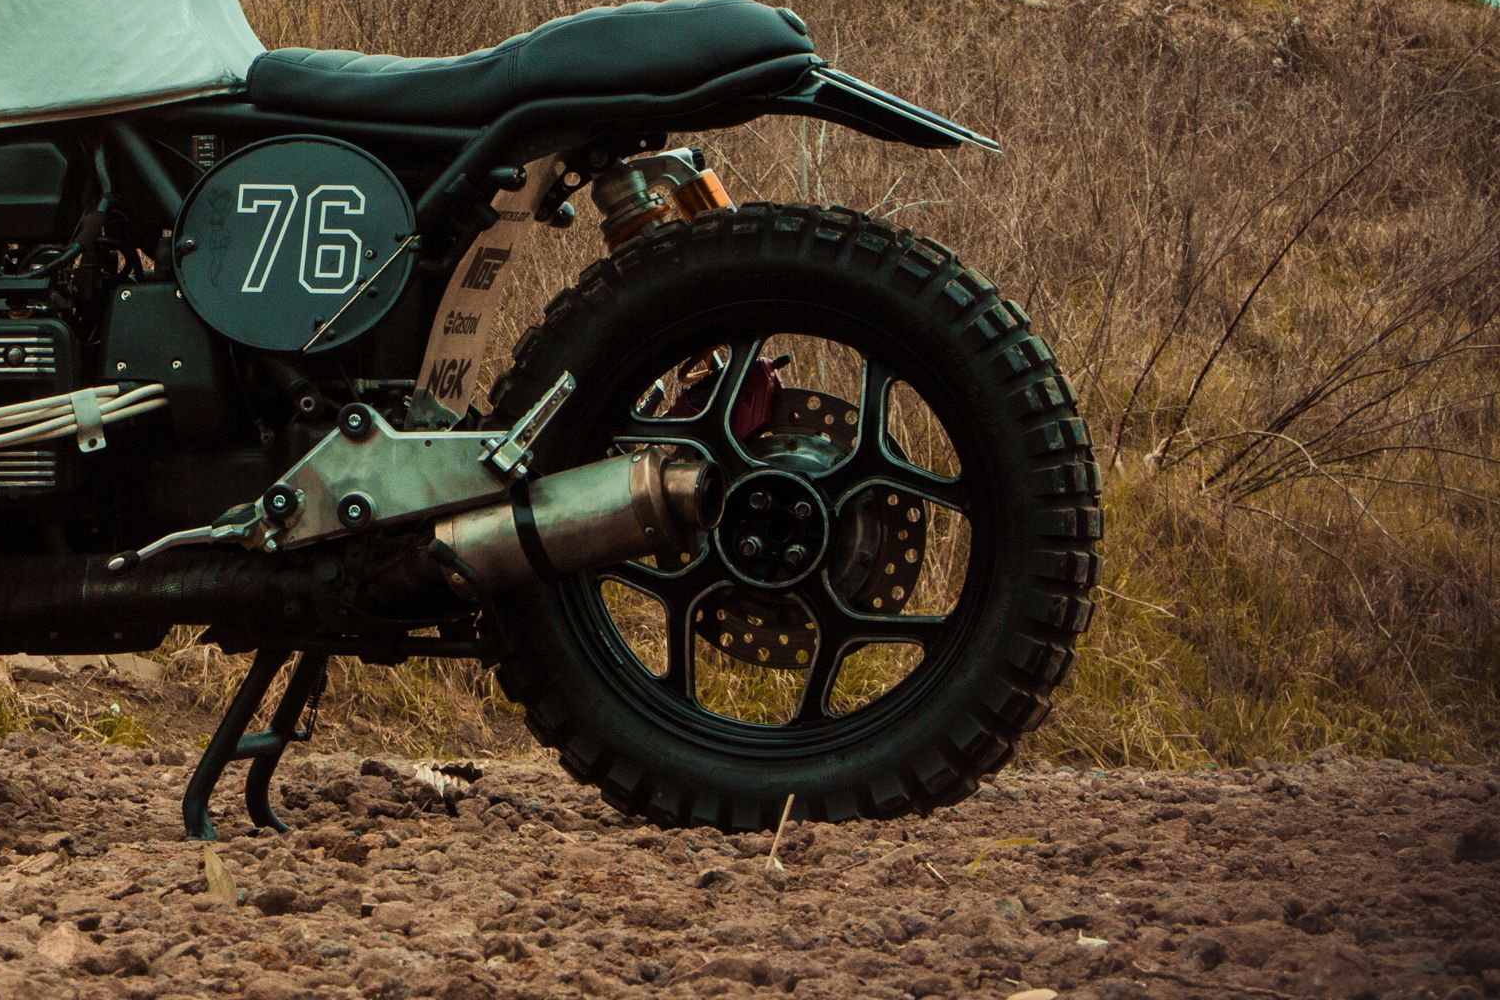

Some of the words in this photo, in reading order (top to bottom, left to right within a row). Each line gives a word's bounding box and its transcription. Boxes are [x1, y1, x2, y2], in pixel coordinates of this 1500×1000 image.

[237, 184, 365, 294] 76
[451, 312, 482, 335] Castrol
[424, 358, 472, 400] NGK
